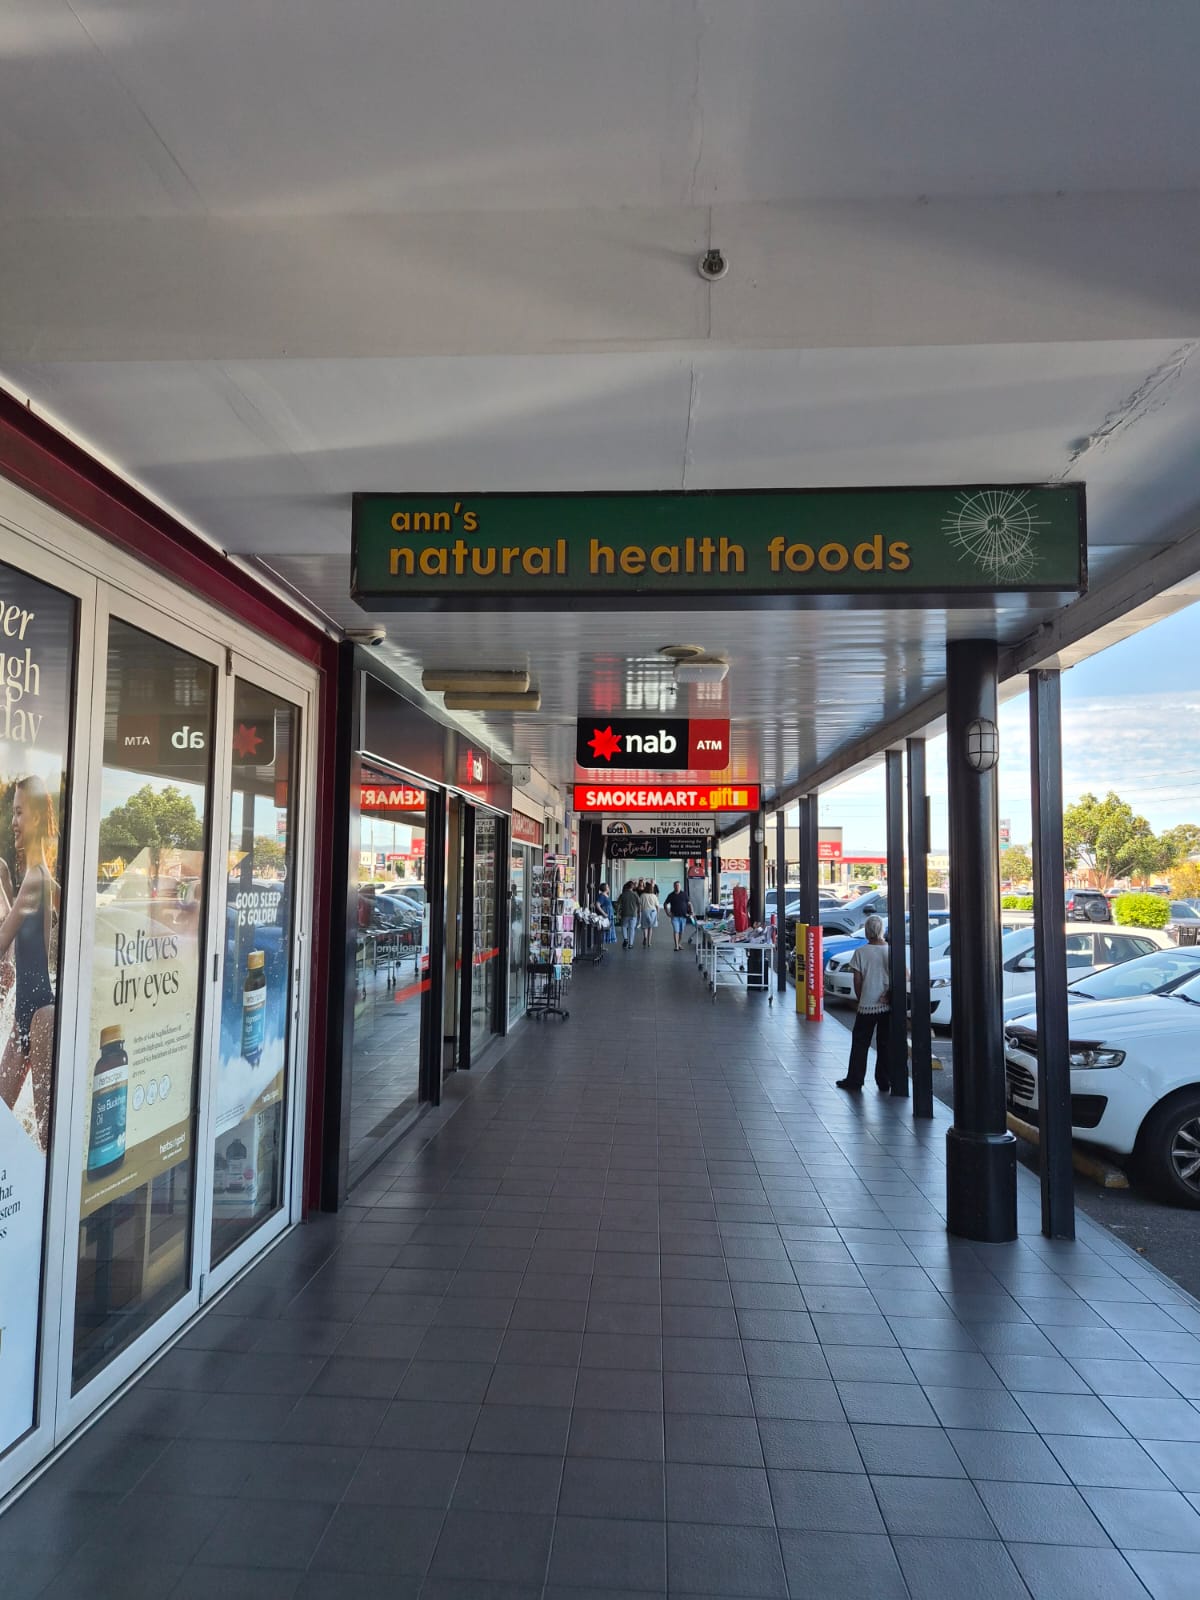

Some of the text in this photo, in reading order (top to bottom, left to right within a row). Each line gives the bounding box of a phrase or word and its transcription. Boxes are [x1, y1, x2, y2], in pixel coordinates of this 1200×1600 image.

[391, 502, 478, 532] ann's
[389, 534, 911, 575] natural health foods
[625, 730, 678, 754] nab
[697, 740, 722, 751] ATM
[585, 791, 698, 807] SMOKEMART
[698, 796, 708, 806] &
[649, 826, 711, 835] NEWSAGENCY
[235, 891, 282, 909] GOOD SLEEP
[237, 907, 278, 927] IS GOLDEN
[114, 929, 179, 967] Relieves
[113, 970, 180, 1012] dry eyes
